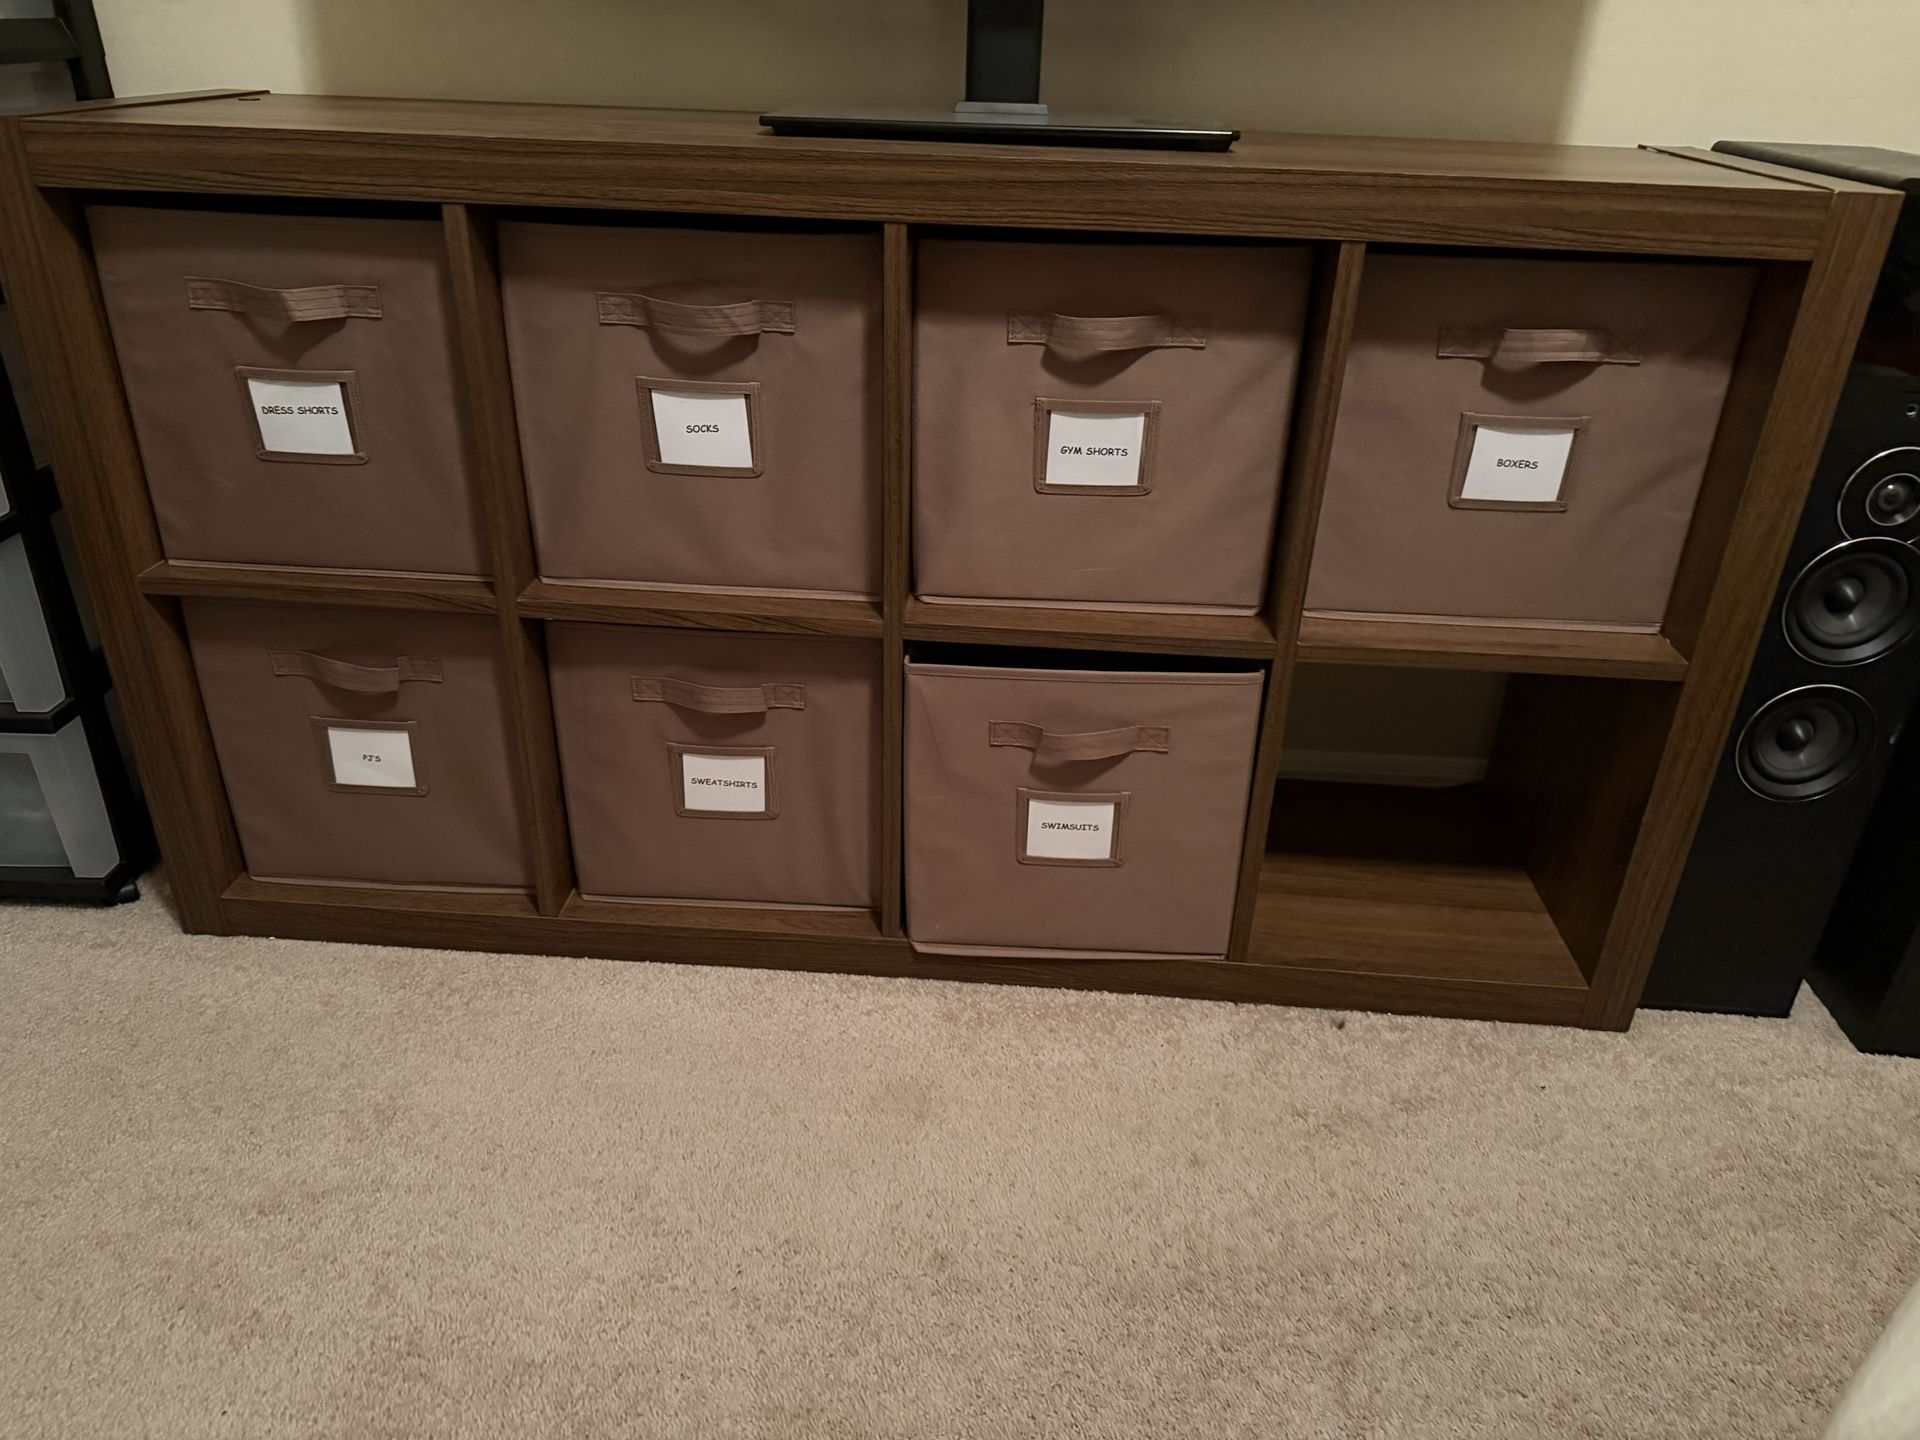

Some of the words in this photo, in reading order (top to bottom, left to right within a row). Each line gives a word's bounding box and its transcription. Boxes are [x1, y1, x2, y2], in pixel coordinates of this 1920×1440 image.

[261, 405, 295, 416] DRESS
[297, 405, 339, 416] SHORTS
[685, 424, 720, 435] SOCKS
[1059, 445, 1083, 456] GYM
[1085, 446, 1129, 458] SHORTS
[1496, 458, 1539, 470] BOXERS
[690, 776, 758, 789] SWEATSHIRTS
[1040, 822, 1100, 832] SWIMSUITS
